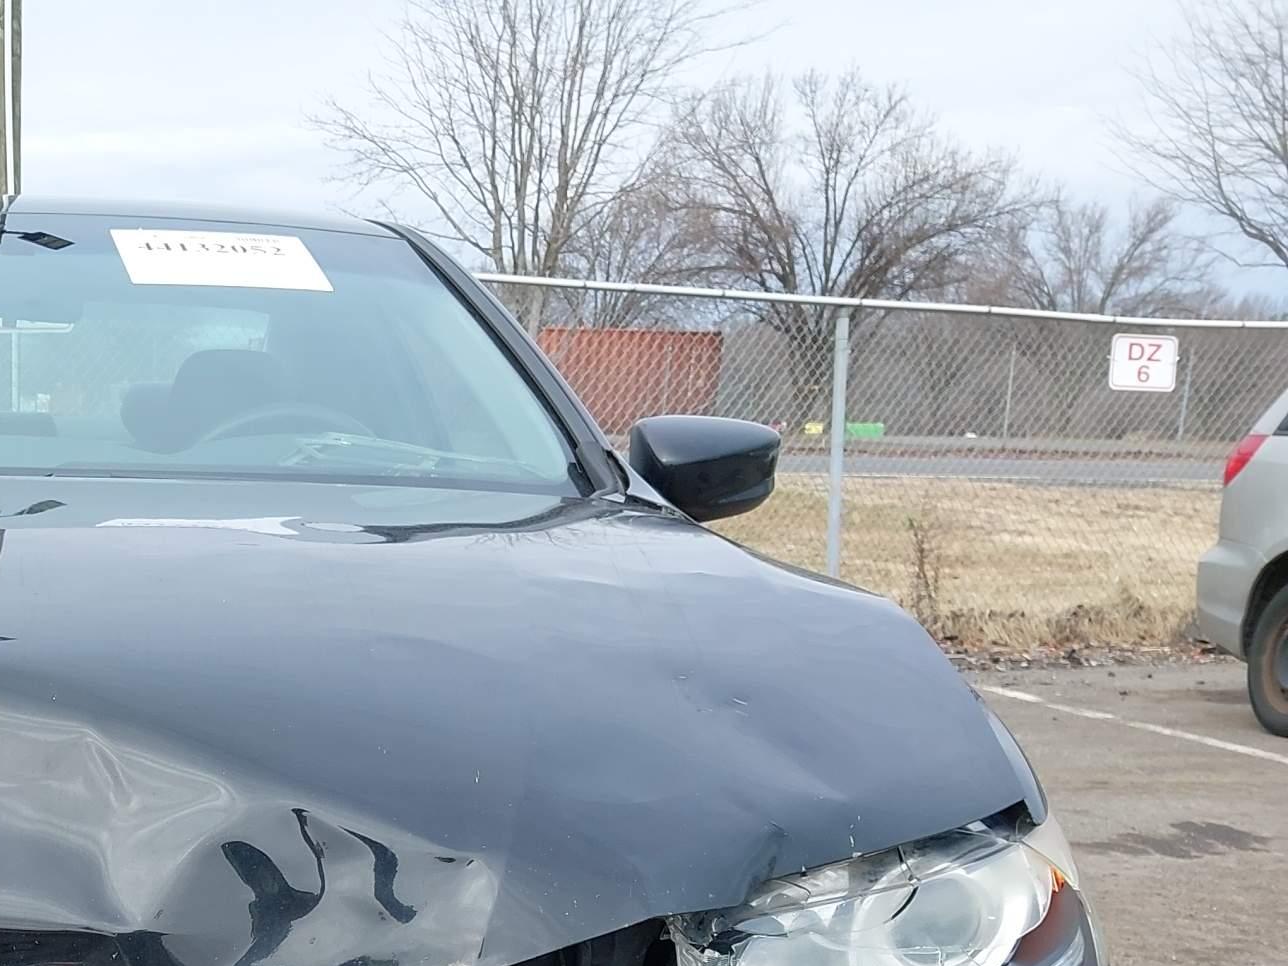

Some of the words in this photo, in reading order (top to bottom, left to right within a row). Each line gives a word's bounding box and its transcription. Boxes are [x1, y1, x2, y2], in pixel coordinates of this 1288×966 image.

[137, 240, 286, 256] 44132052
[1128, 342, 1163, 362] DZ
[1137, 365, 1150, 383] 6
